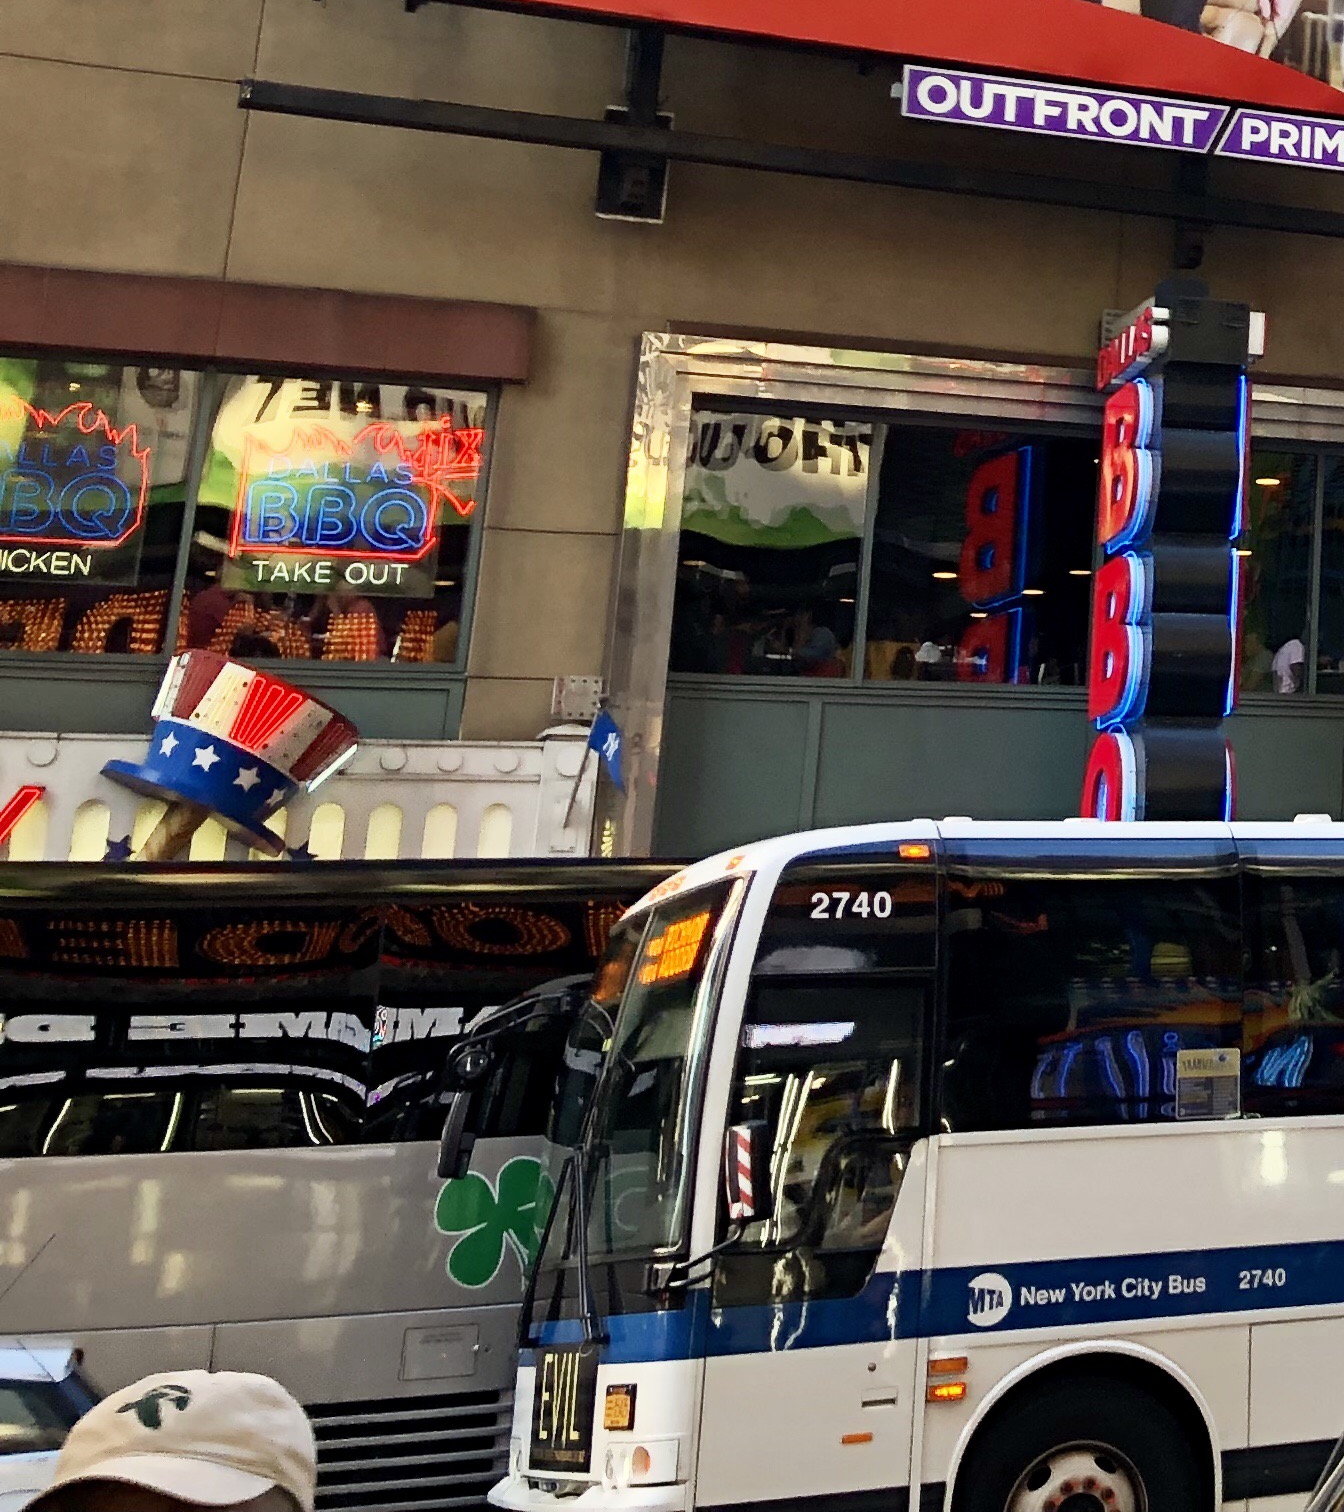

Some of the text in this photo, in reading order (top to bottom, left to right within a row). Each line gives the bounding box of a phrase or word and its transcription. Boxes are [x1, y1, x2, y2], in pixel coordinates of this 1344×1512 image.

[916, 75, 1209, 146] OUTFRONT
[269, 456, 414, 485] DALLAS
[245, 480, 428, 551] BBQ
[0, 549, 92, 576] ICKEN
[252, 560, 409, 586] TAKE OUT
[810, 891, 893, 919] 2740
[1238, 1268, 1287, 1290] 2740
[968, 1274, 1207, 1316] MTA New York City Bus
[538, 1352, 581, 1449] EVIL
